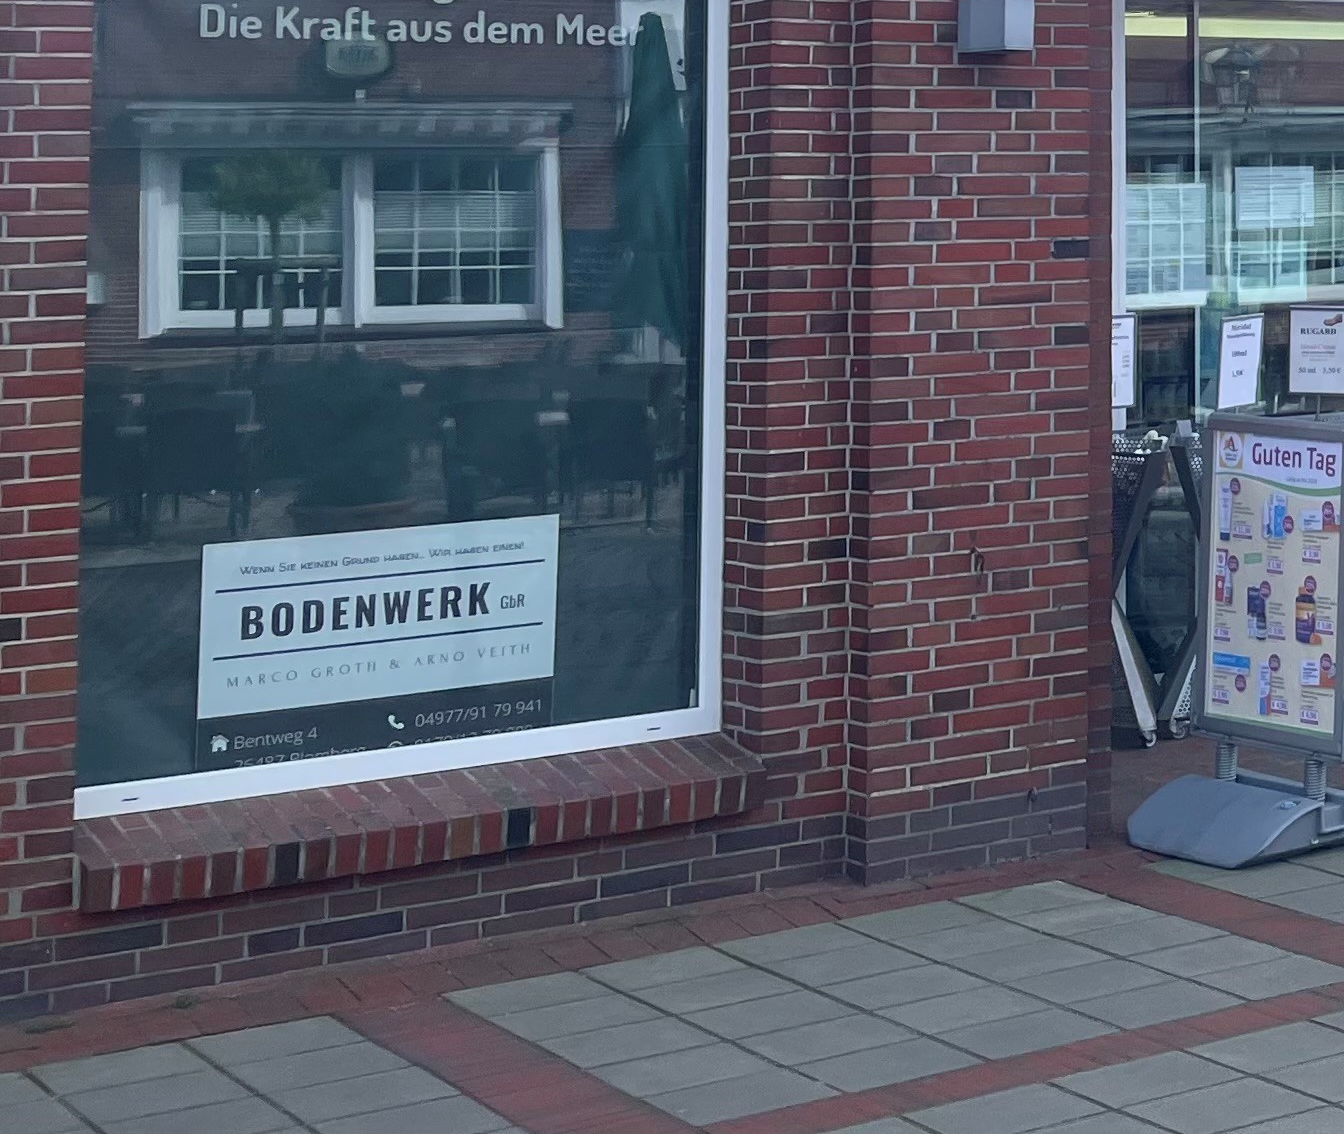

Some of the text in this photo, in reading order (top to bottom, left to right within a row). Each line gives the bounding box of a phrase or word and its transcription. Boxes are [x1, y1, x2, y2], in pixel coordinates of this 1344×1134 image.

[200, 3, 645, 47] Die Kraft aus dem Meer
[1252, 443, 1336, 477] Guten Tag
[240, 582, 525, 640] BODENWERK GbR
[226, 643, 531, 688] MARCO GROTH & ARNO VEITH
[415, 699, 542, 728] 04977/91 79 941
[234, 726, 319, 749] Bentweg 4
